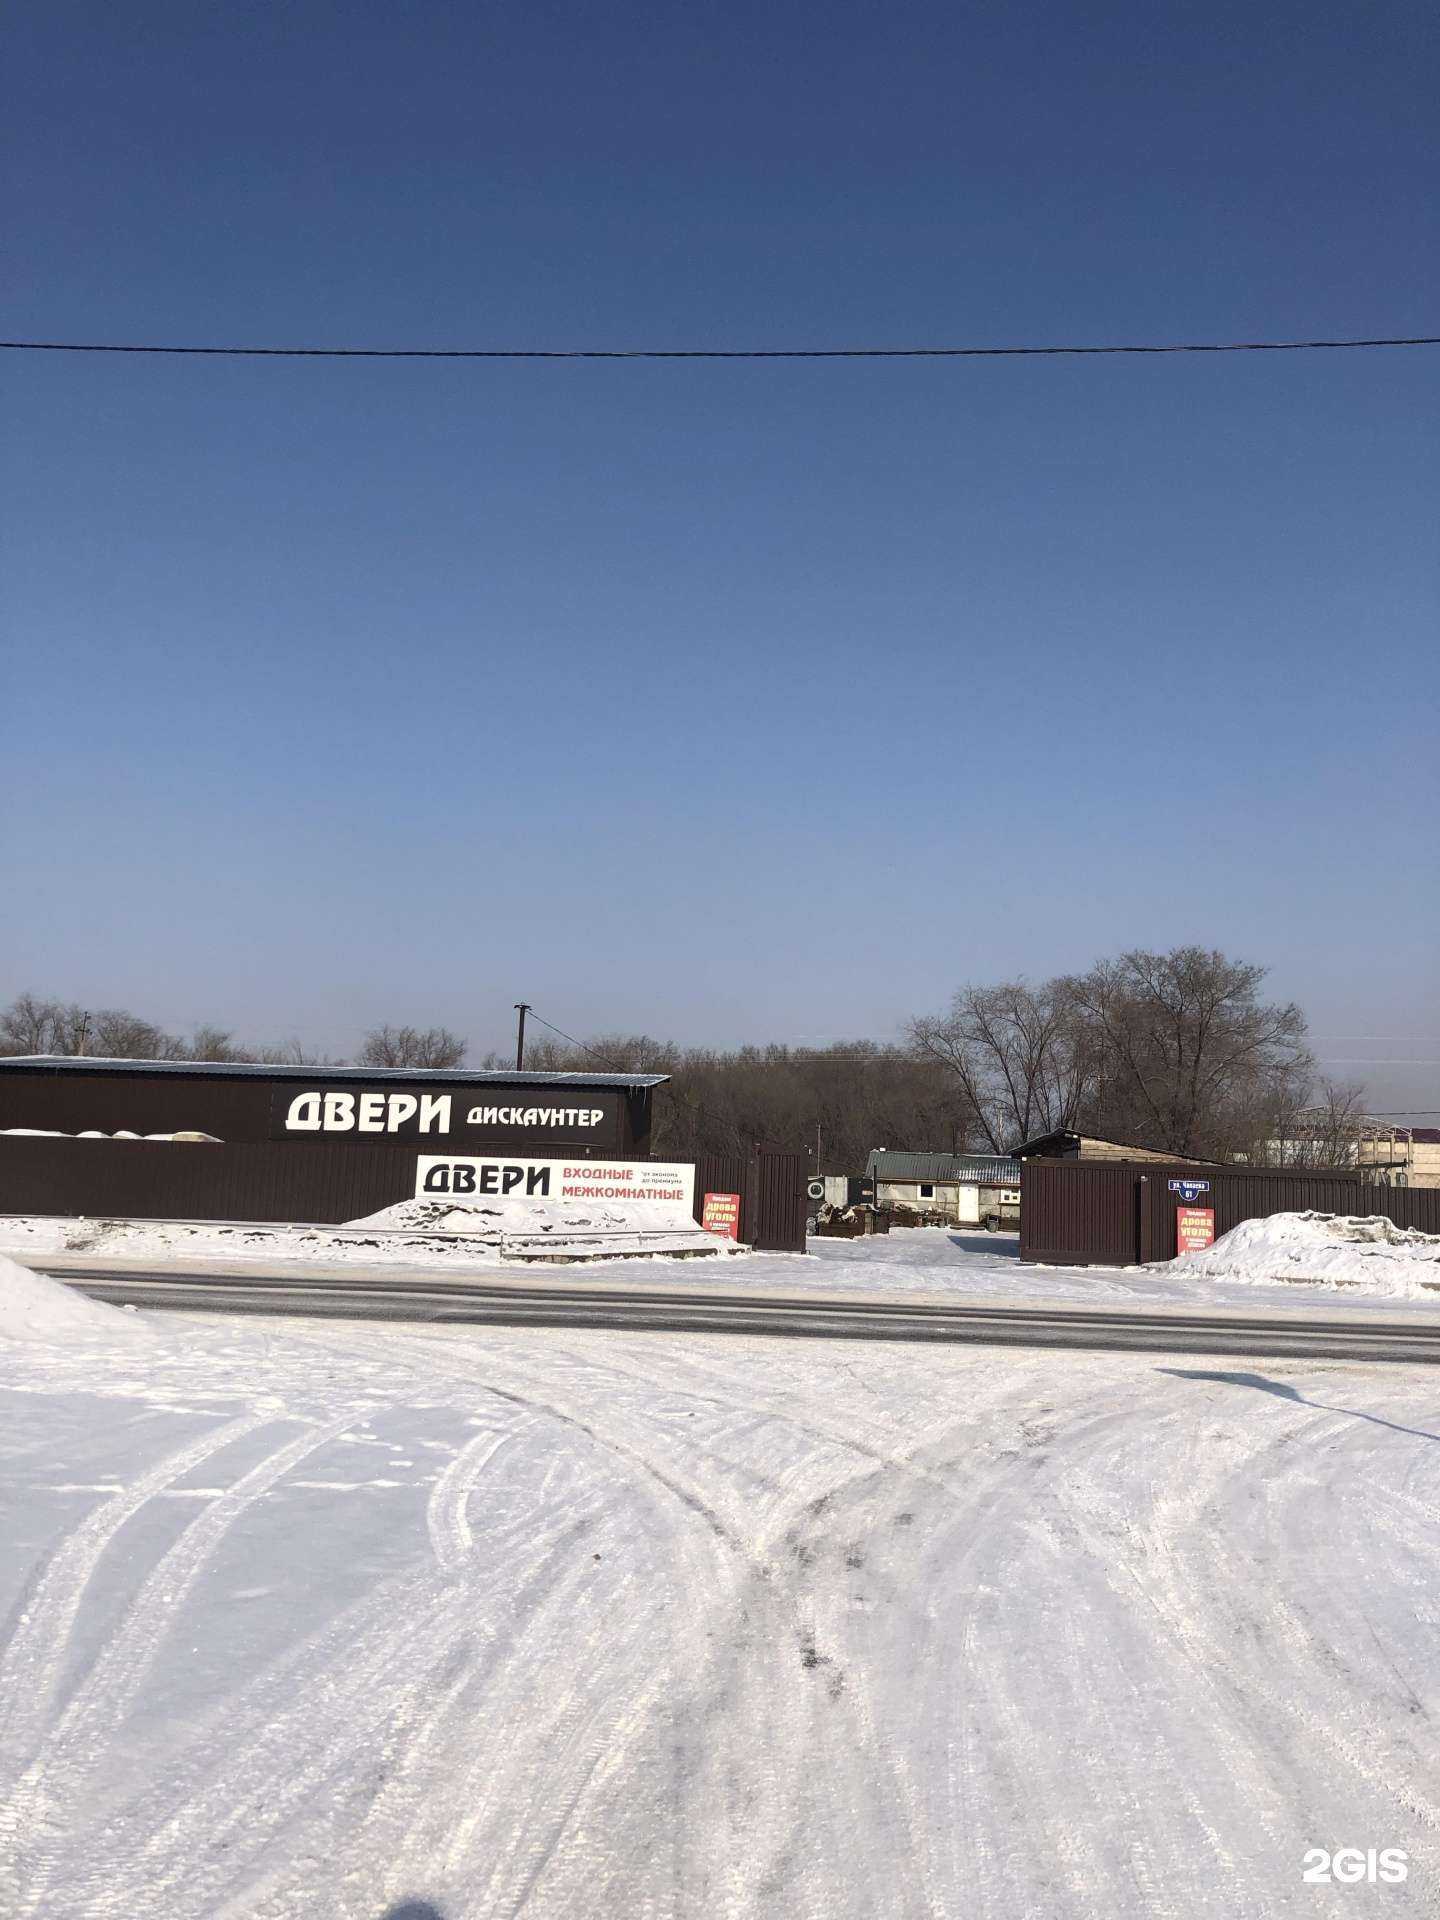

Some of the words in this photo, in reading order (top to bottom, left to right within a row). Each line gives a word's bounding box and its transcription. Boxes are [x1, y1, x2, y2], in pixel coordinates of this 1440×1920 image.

[285, 1092, 452, 1134] ДВЕРИ
[466, 1106, 604, 1128] ДИСКАУНТЕР
[423, 1163, 551, 1197] ДВЕРИ
[563, 1167, 633, 1180] ВХОДНЫЕ
[562, 1186, 684, 1201] МЕЖКОМНАТНЫЕ
